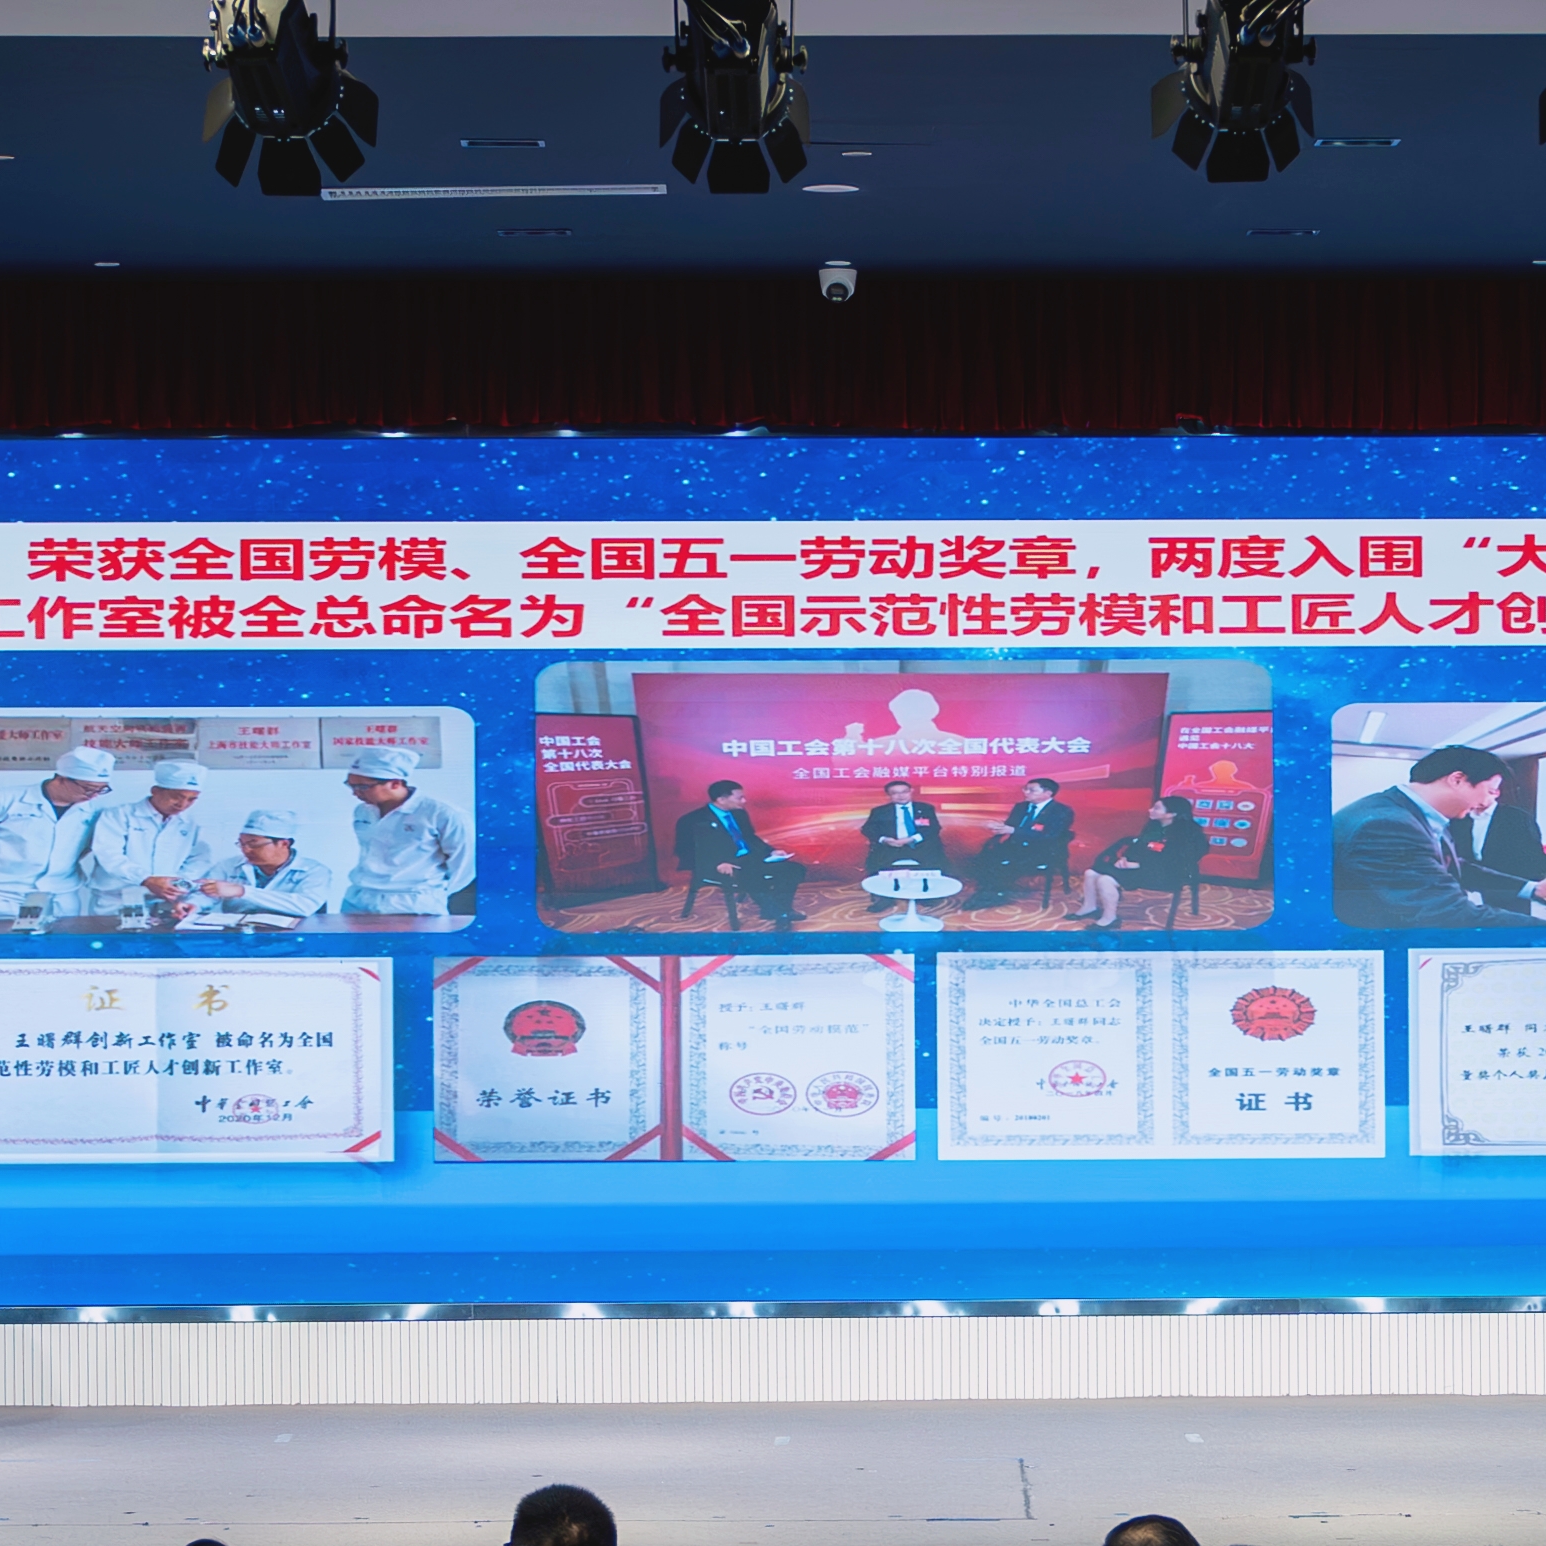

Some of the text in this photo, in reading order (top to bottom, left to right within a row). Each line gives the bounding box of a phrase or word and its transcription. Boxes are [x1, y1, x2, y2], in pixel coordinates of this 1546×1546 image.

[539, 735, 601, 747] 中国工会
[722, 736, 1092, 758] 中国工会第十八次全国代表大会
[543, 759, 632, 773] 全国代表大会
[792, 764, 1027, 781] 全国工会融媒平台特别报道
[82, 984, 231, 1017] 证书
[1208, 1066, 1342, 1078] 全国五一劳动奖章
[475, 1086, 613, 1109] 荣誉证书
[1235, 1091, 1315, 1113] 证书
